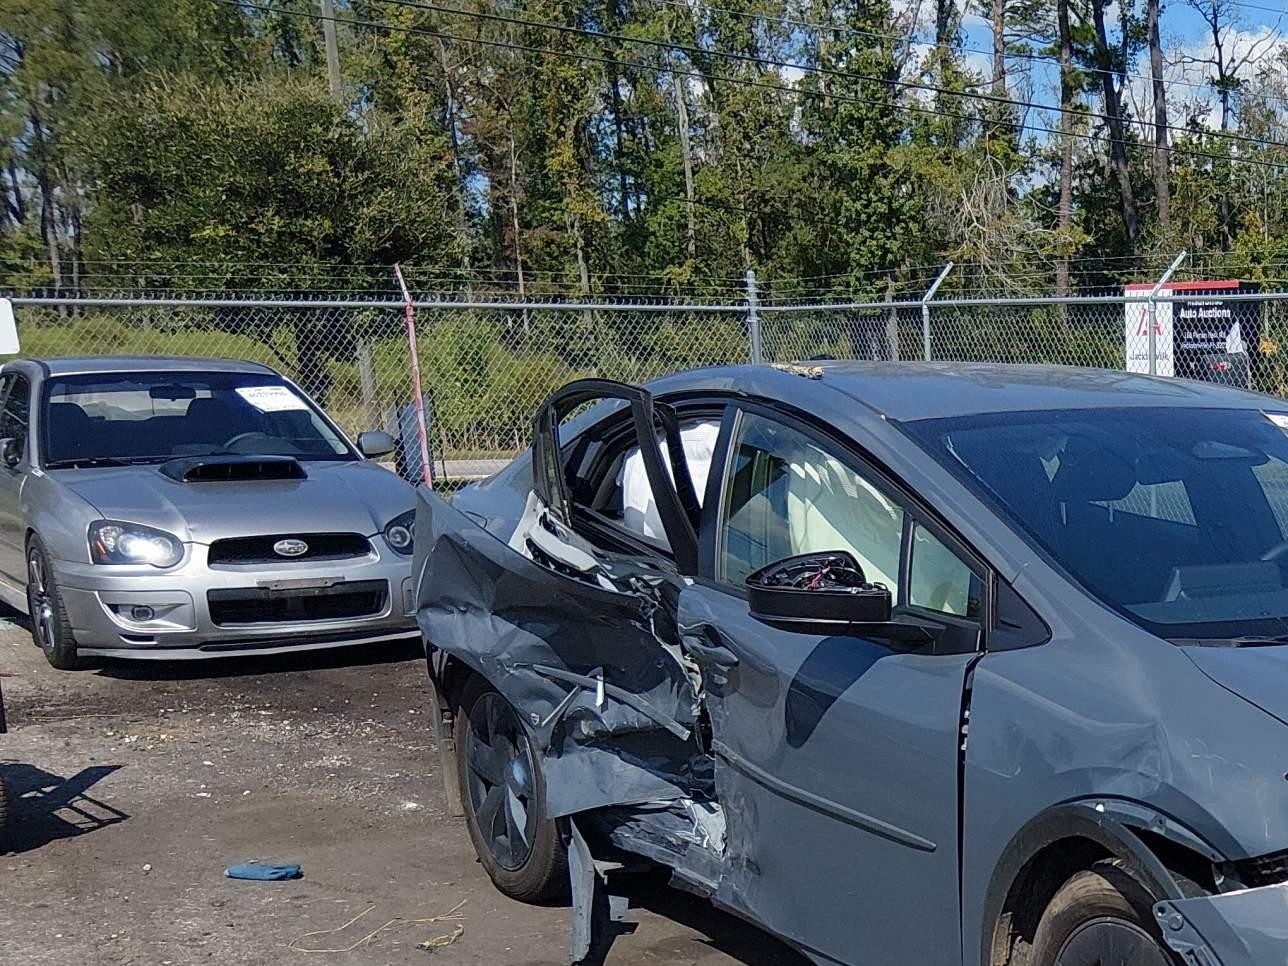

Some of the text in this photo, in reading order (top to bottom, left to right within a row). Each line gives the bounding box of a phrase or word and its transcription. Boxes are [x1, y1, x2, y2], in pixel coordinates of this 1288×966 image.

[1180, 307, 1231, 318] Auto Auctions
[1129, 351, 1169, 361] Jacksville
